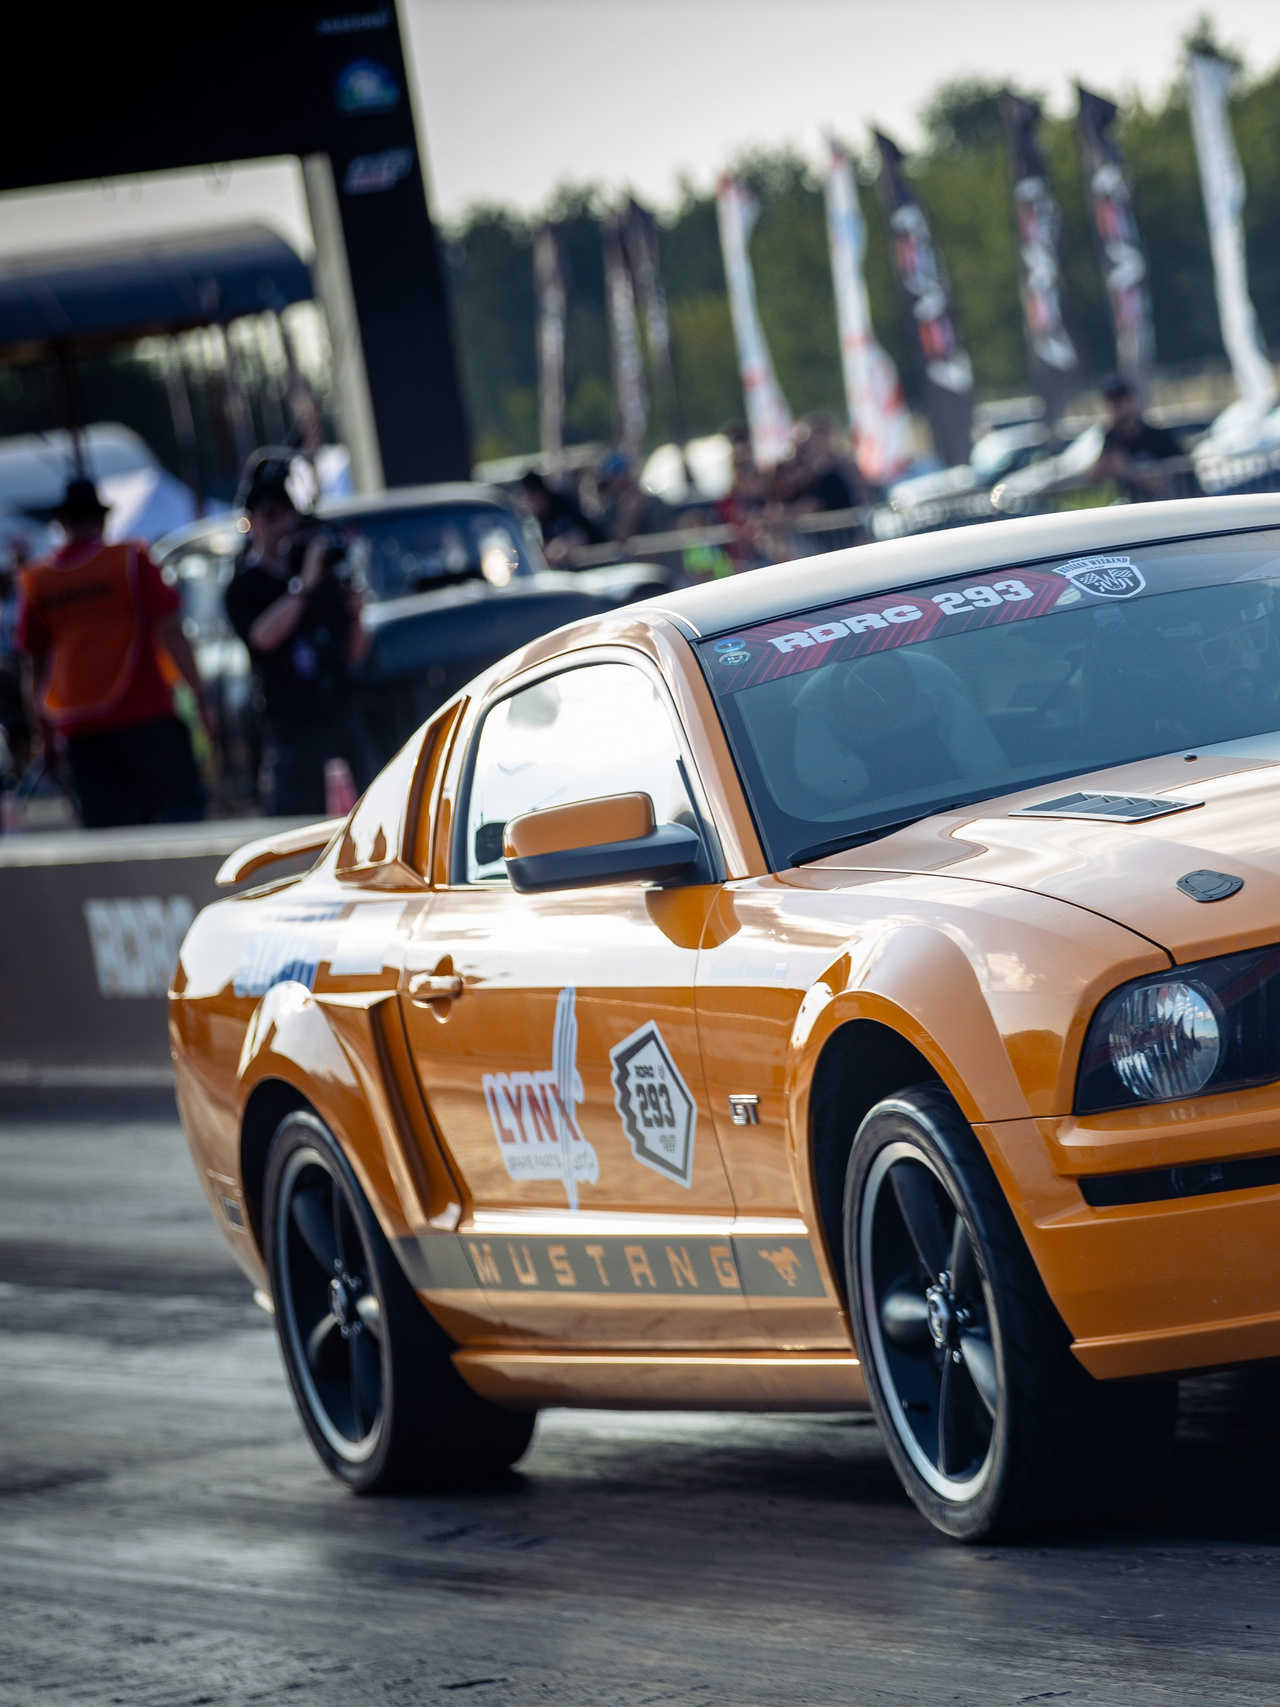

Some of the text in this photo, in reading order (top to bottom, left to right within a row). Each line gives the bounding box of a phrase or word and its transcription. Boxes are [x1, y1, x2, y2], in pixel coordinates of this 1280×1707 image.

[1088, 557, 1128, 567] WEEKEND
[768, 578, 1036, 654] RDRC 293
[487, 1082, 581, 1143] LYNX
[635, 1083, 676, 1128] 293
[468, 1242, 741, 1290] MUSTANG
